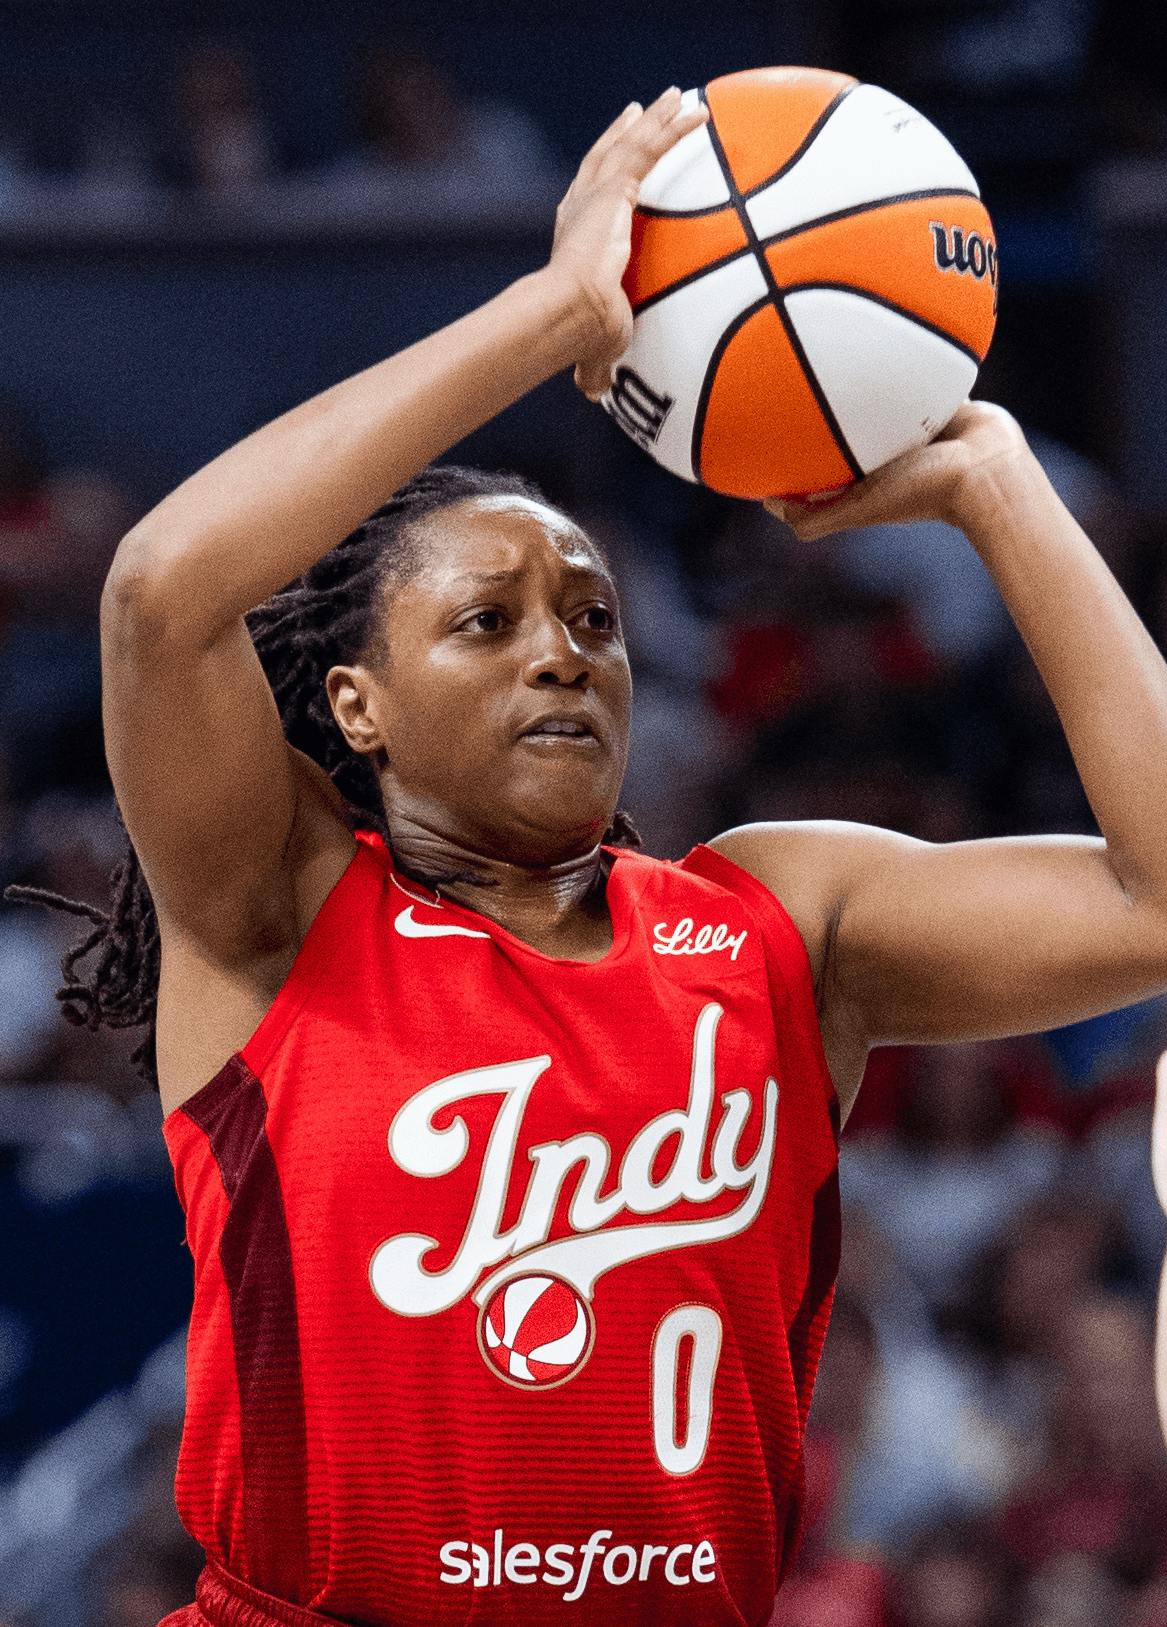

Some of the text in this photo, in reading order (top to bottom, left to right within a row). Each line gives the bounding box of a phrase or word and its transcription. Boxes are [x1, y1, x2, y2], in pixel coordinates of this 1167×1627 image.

[652, 917, 748, 961] Lilly
[368, 1002, 780, 1318] Indy
[650, 1302, 723, 1477] 0
[439, 1528, 716, 1602] salesforce
